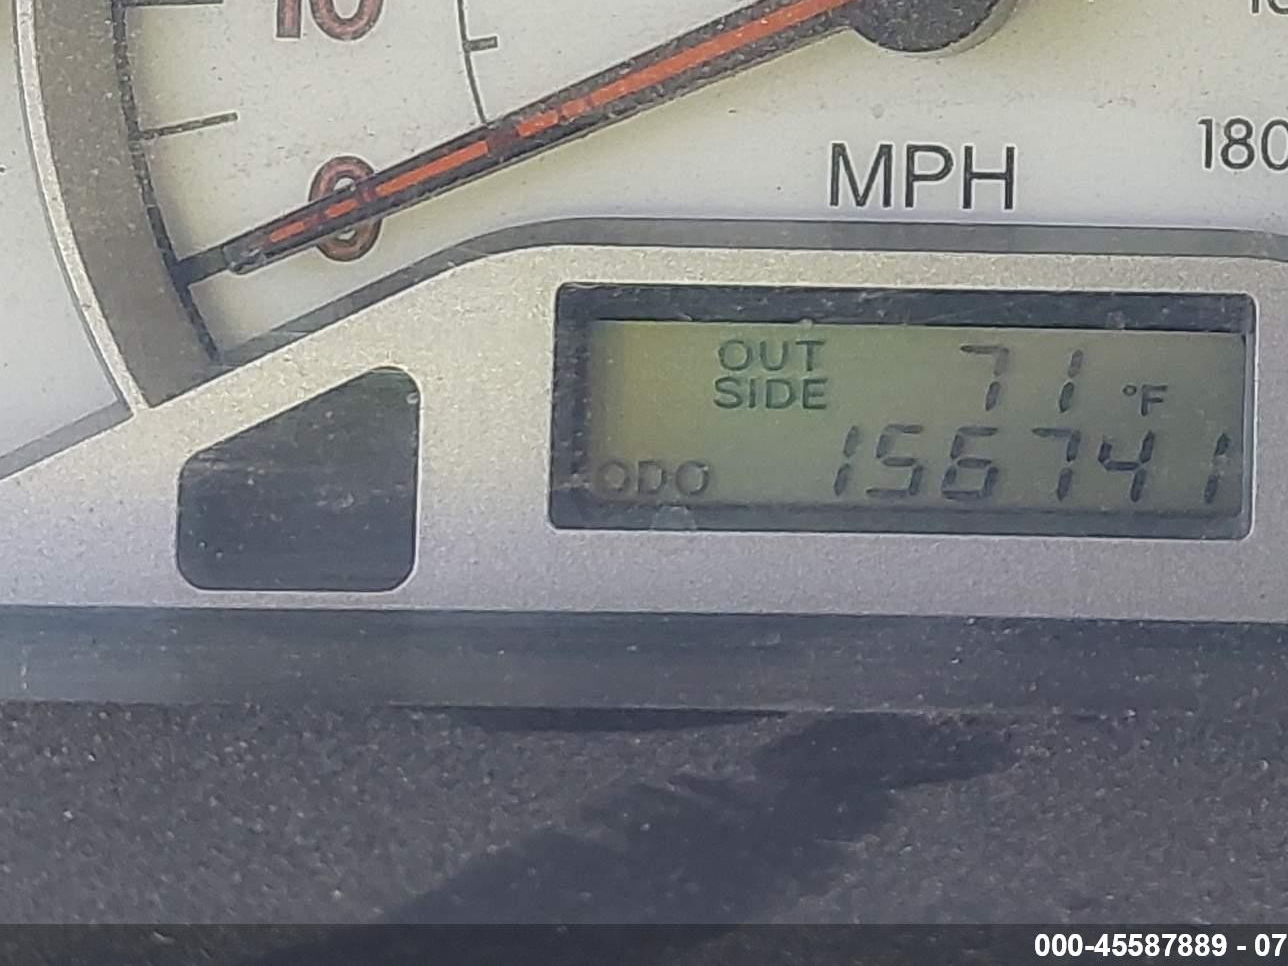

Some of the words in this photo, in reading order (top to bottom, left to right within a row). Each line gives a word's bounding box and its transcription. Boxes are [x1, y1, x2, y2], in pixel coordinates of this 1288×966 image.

[830, 141, 1017, 210] MPH
[717, 339, 826, 372] OUT
[960, 344, 1084, 412] 71
[713, 376, 829, 410] SIDE
[593, 458, 711, 498] ODO
[830, 423, 1230, 506] 156741
